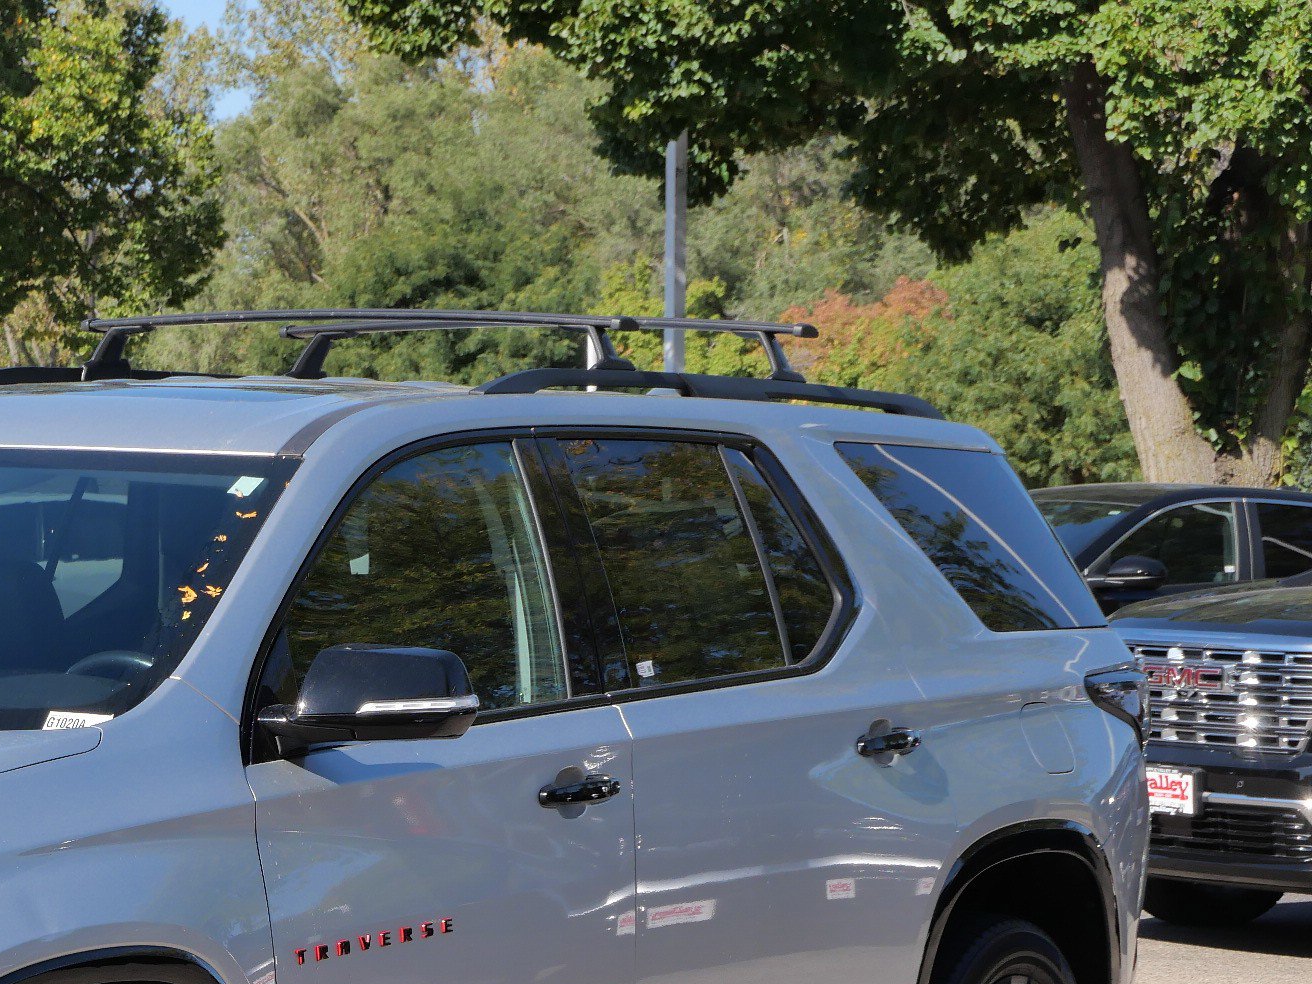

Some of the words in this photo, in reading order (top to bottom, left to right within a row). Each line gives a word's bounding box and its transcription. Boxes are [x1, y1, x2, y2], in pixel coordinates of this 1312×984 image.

[1142, 665, 1221, 688] GMC
[46, 717, 86, 729] G1020A
[1146, 774, 1189, 801] alley
[293, 916, 455, 966] TRAVERSE
